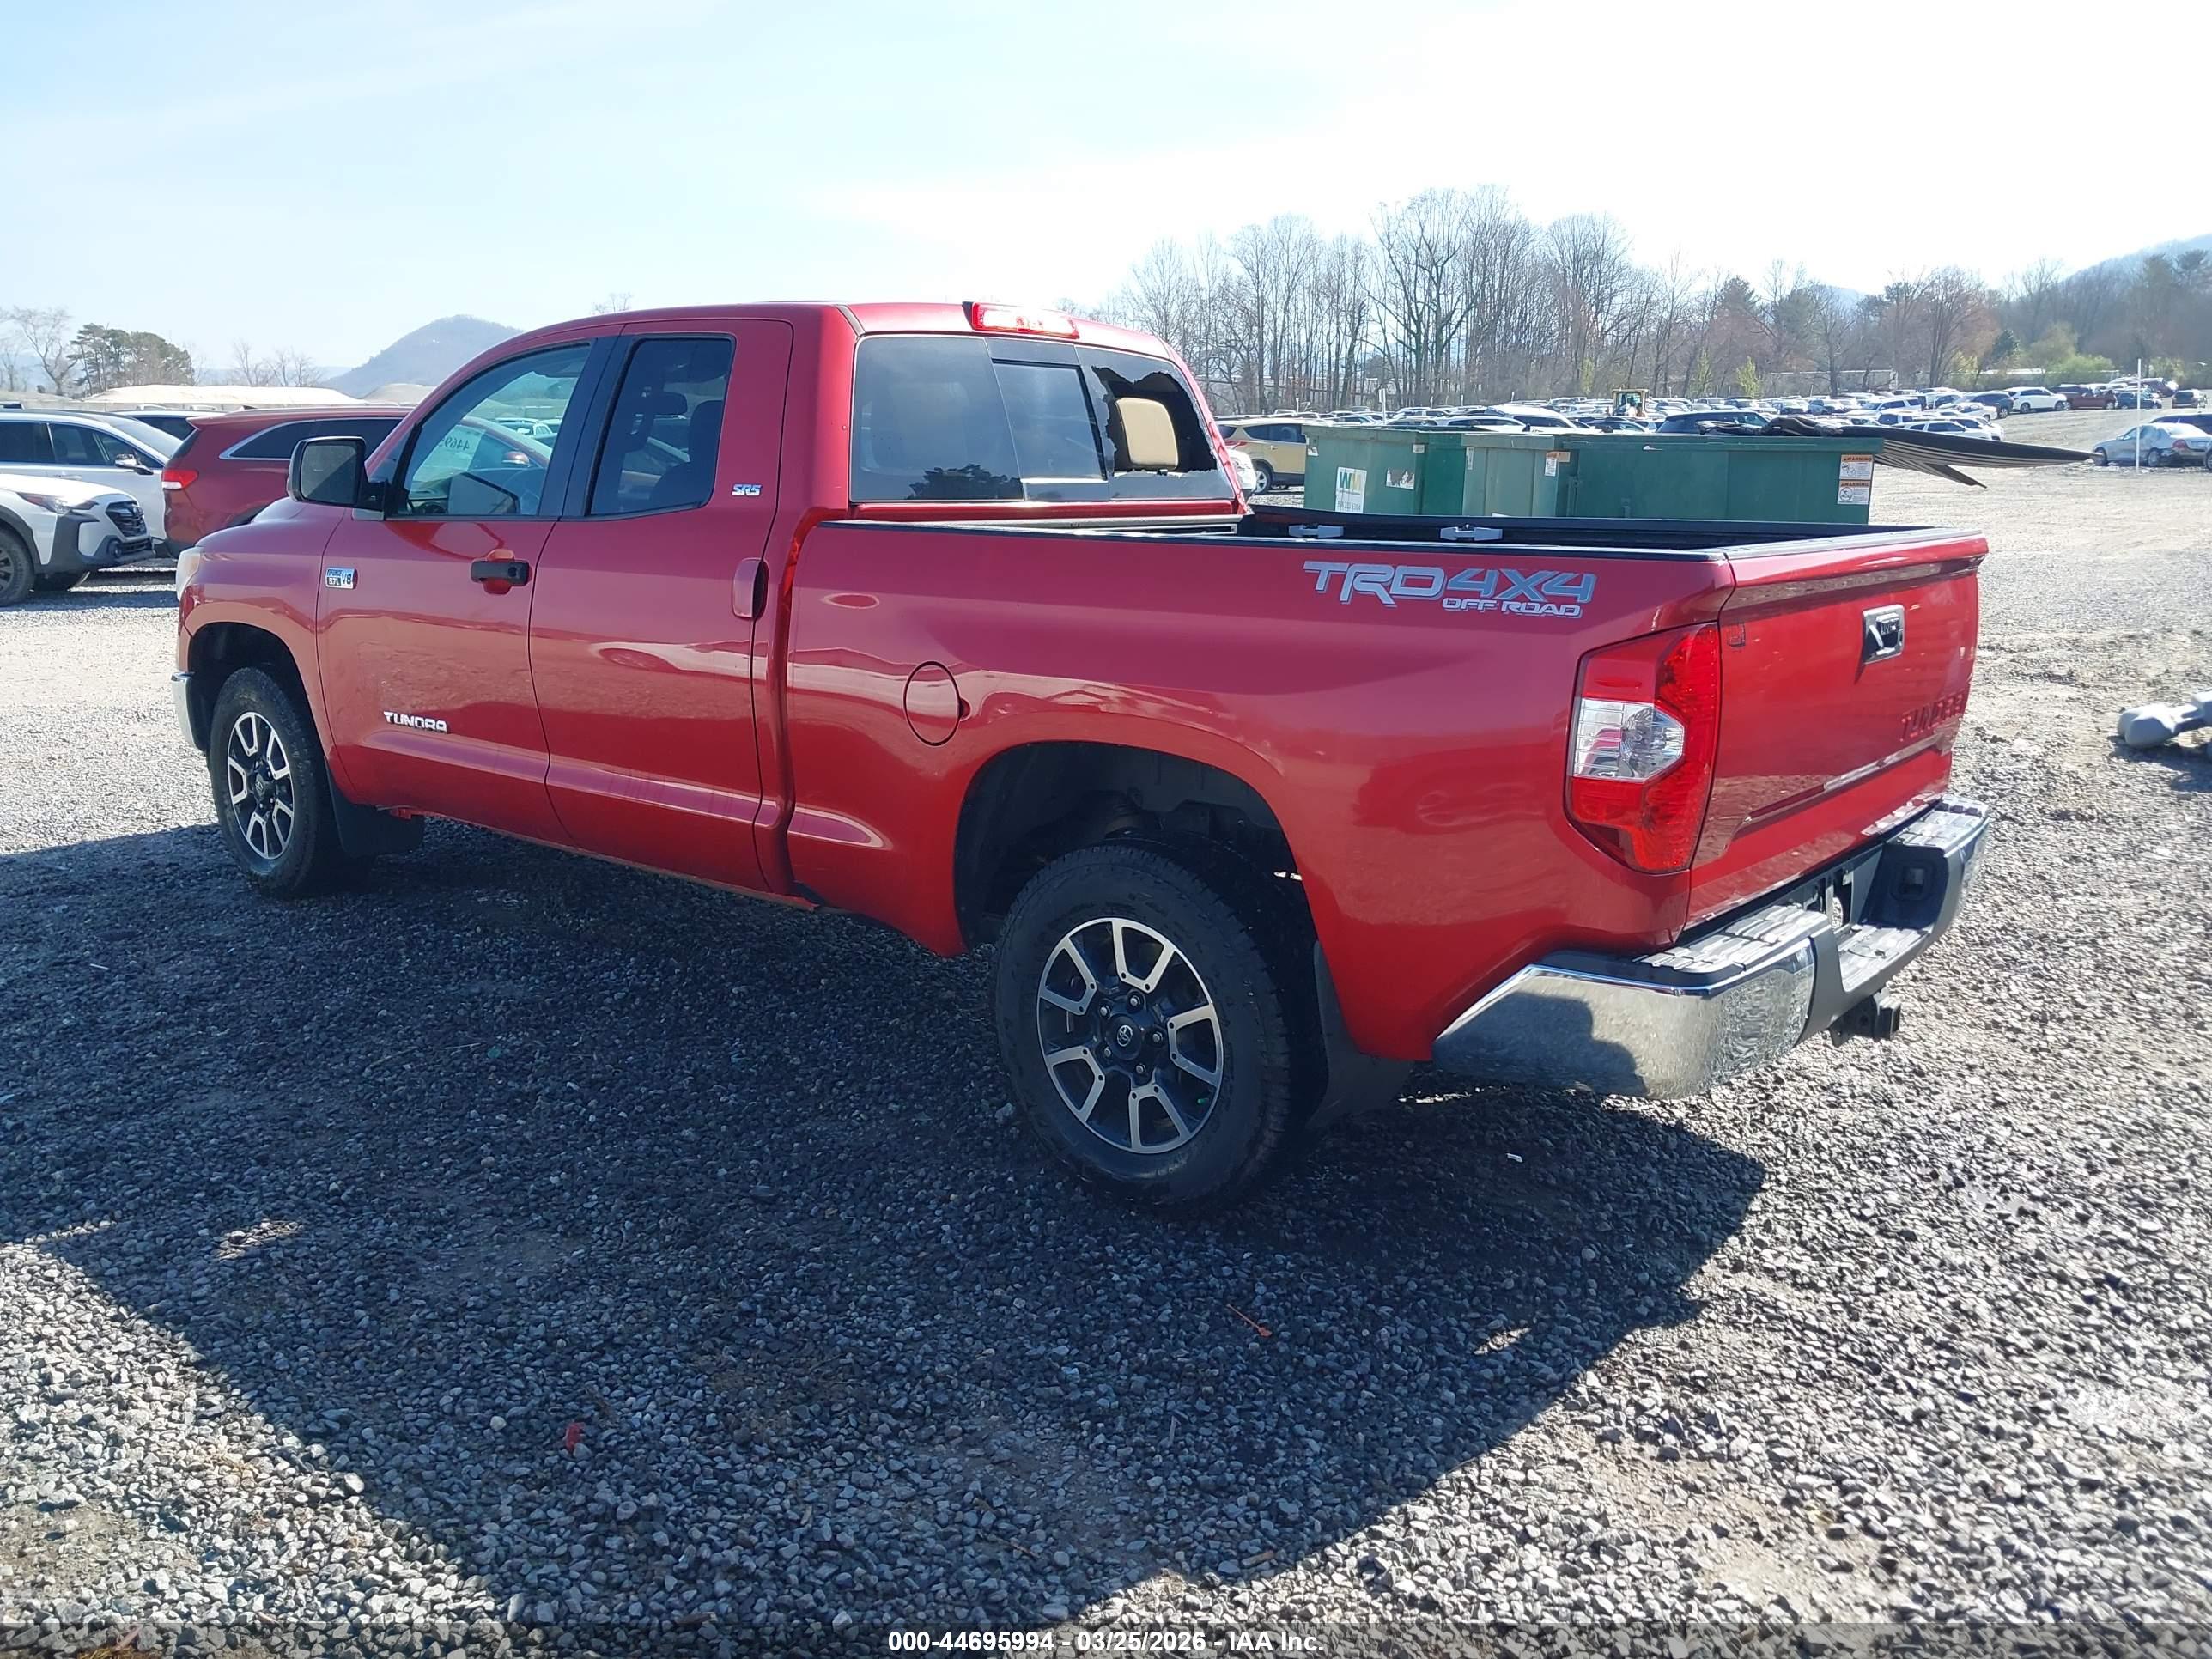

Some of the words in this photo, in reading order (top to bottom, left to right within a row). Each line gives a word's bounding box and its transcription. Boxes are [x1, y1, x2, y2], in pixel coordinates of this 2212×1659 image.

[342, 573, 353, 585] V8
[1303, 561, 1448, 607] TRD
[1448, 568, 1599, 603] 4X4
[1443, 598, 1498, 613] OFF
[1501, 601, 1583, 618] ROAD
[383, 711, 447, 733] TUNDRA
